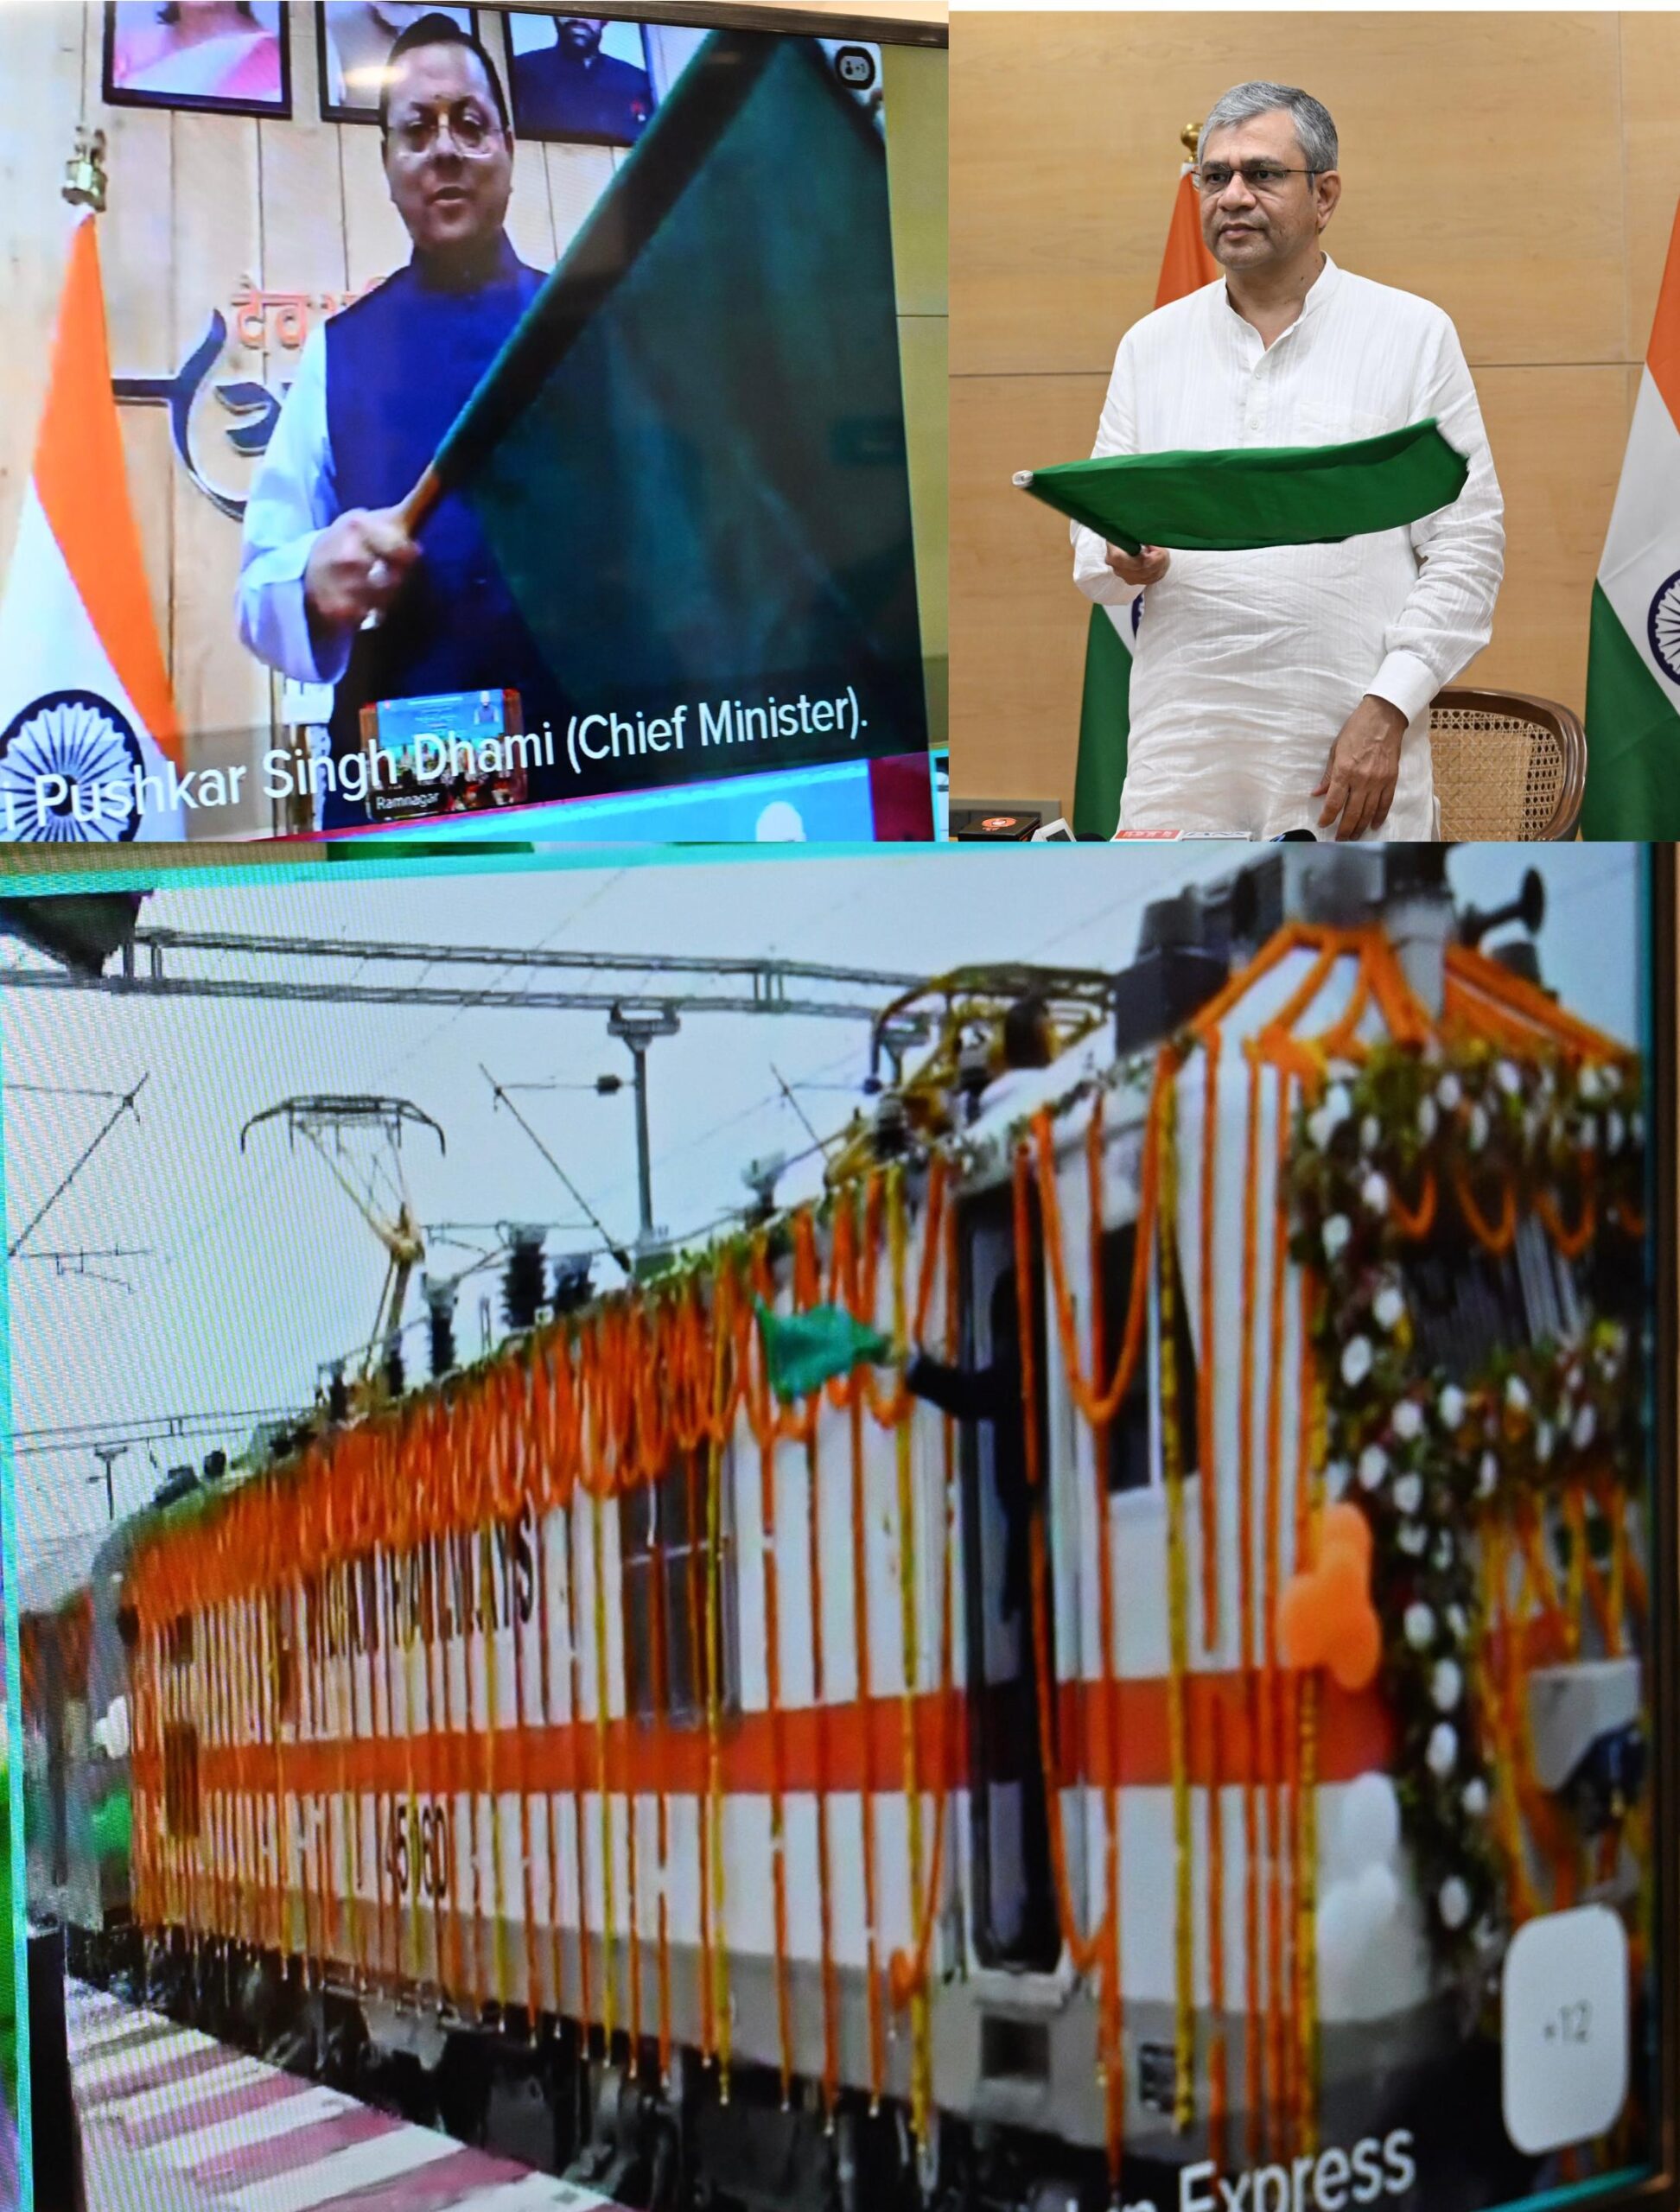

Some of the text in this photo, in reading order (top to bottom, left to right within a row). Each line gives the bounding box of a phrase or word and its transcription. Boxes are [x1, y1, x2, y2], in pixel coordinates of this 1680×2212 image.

[35, 760, 246, 827] Pushkar
[263, 739, 398, 802] Singh
[414, 721, 554, 781] Dhami
[567, 705, 688, 774] (Chief
[698, 685, 869, 747] Minister).
[376, 791, 440, 810] Ramnagar
[1179, 2128, 1416, 2212] Express
